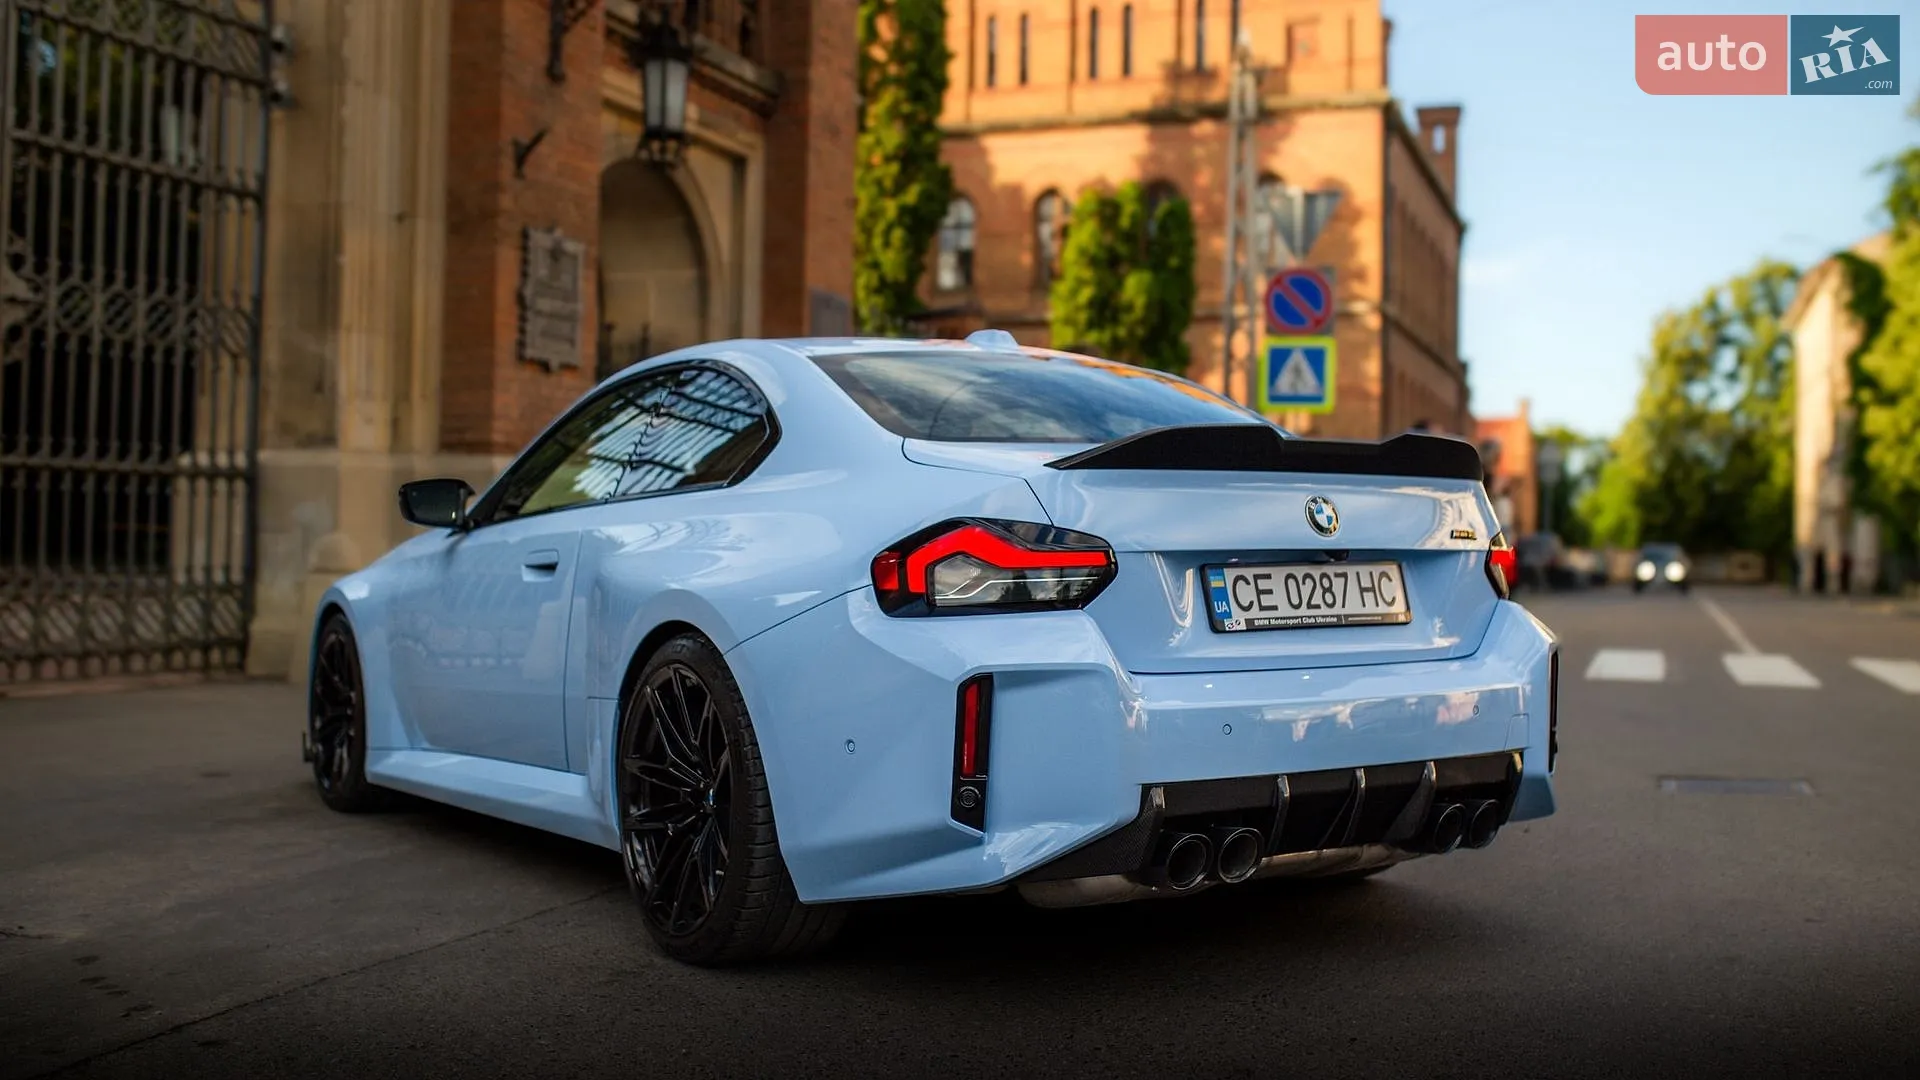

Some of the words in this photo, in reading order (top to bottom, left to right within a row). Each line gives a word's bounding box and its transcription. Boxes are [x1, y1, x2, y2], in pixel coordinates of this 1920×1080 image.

[1232, 573, 1278, 612] CE
[1284, 571, 1349, 610] 0287
[1356, 570, 1396, 608] HC
[1214, 601, 1230, 613] UA
[1270, 617, 1301, 627] Motorsport
[1302, 616, 1315, 625] Club
[1316, 616, 1338, 624] Ukraine
